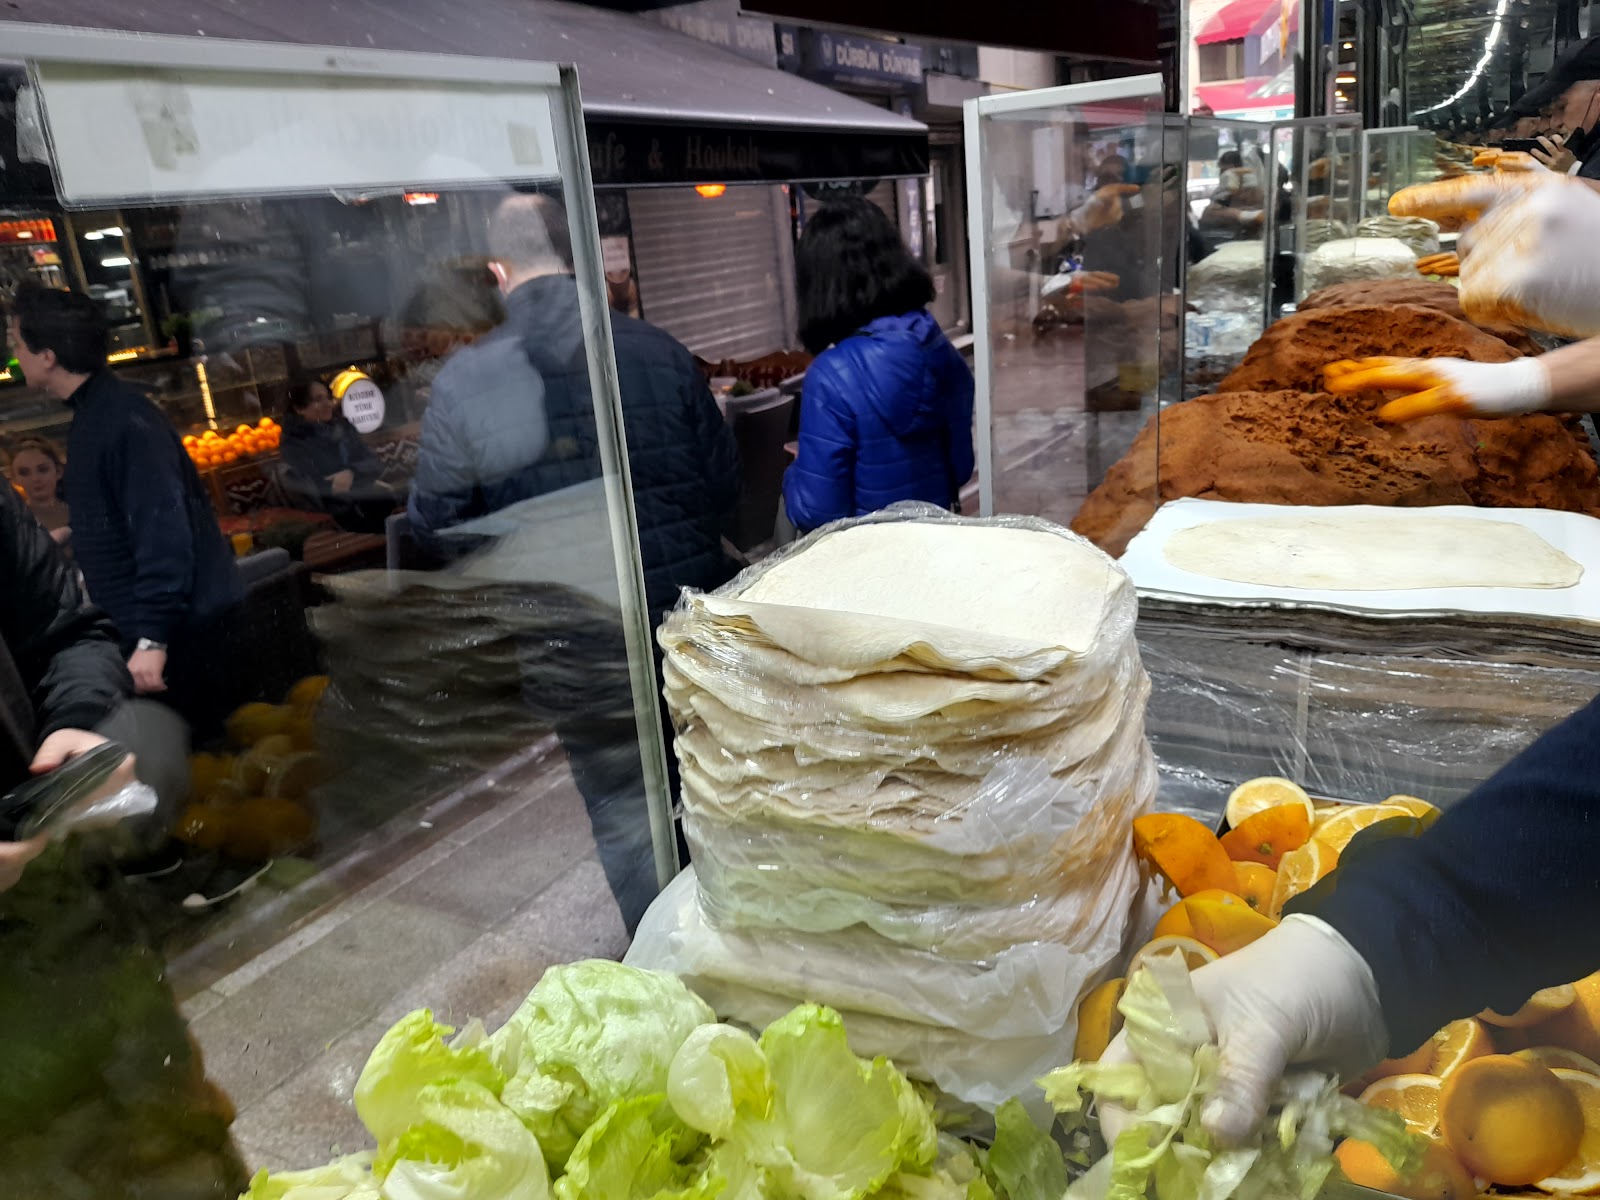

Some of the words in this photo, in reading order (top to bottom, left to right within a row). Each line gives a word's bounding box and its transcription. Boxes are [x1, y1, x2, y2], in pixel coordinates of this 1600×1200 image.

[592, 131, 626, 178] afe
[648, 137, 664, 169] &
[686, 135, 760, 169] Hookah
